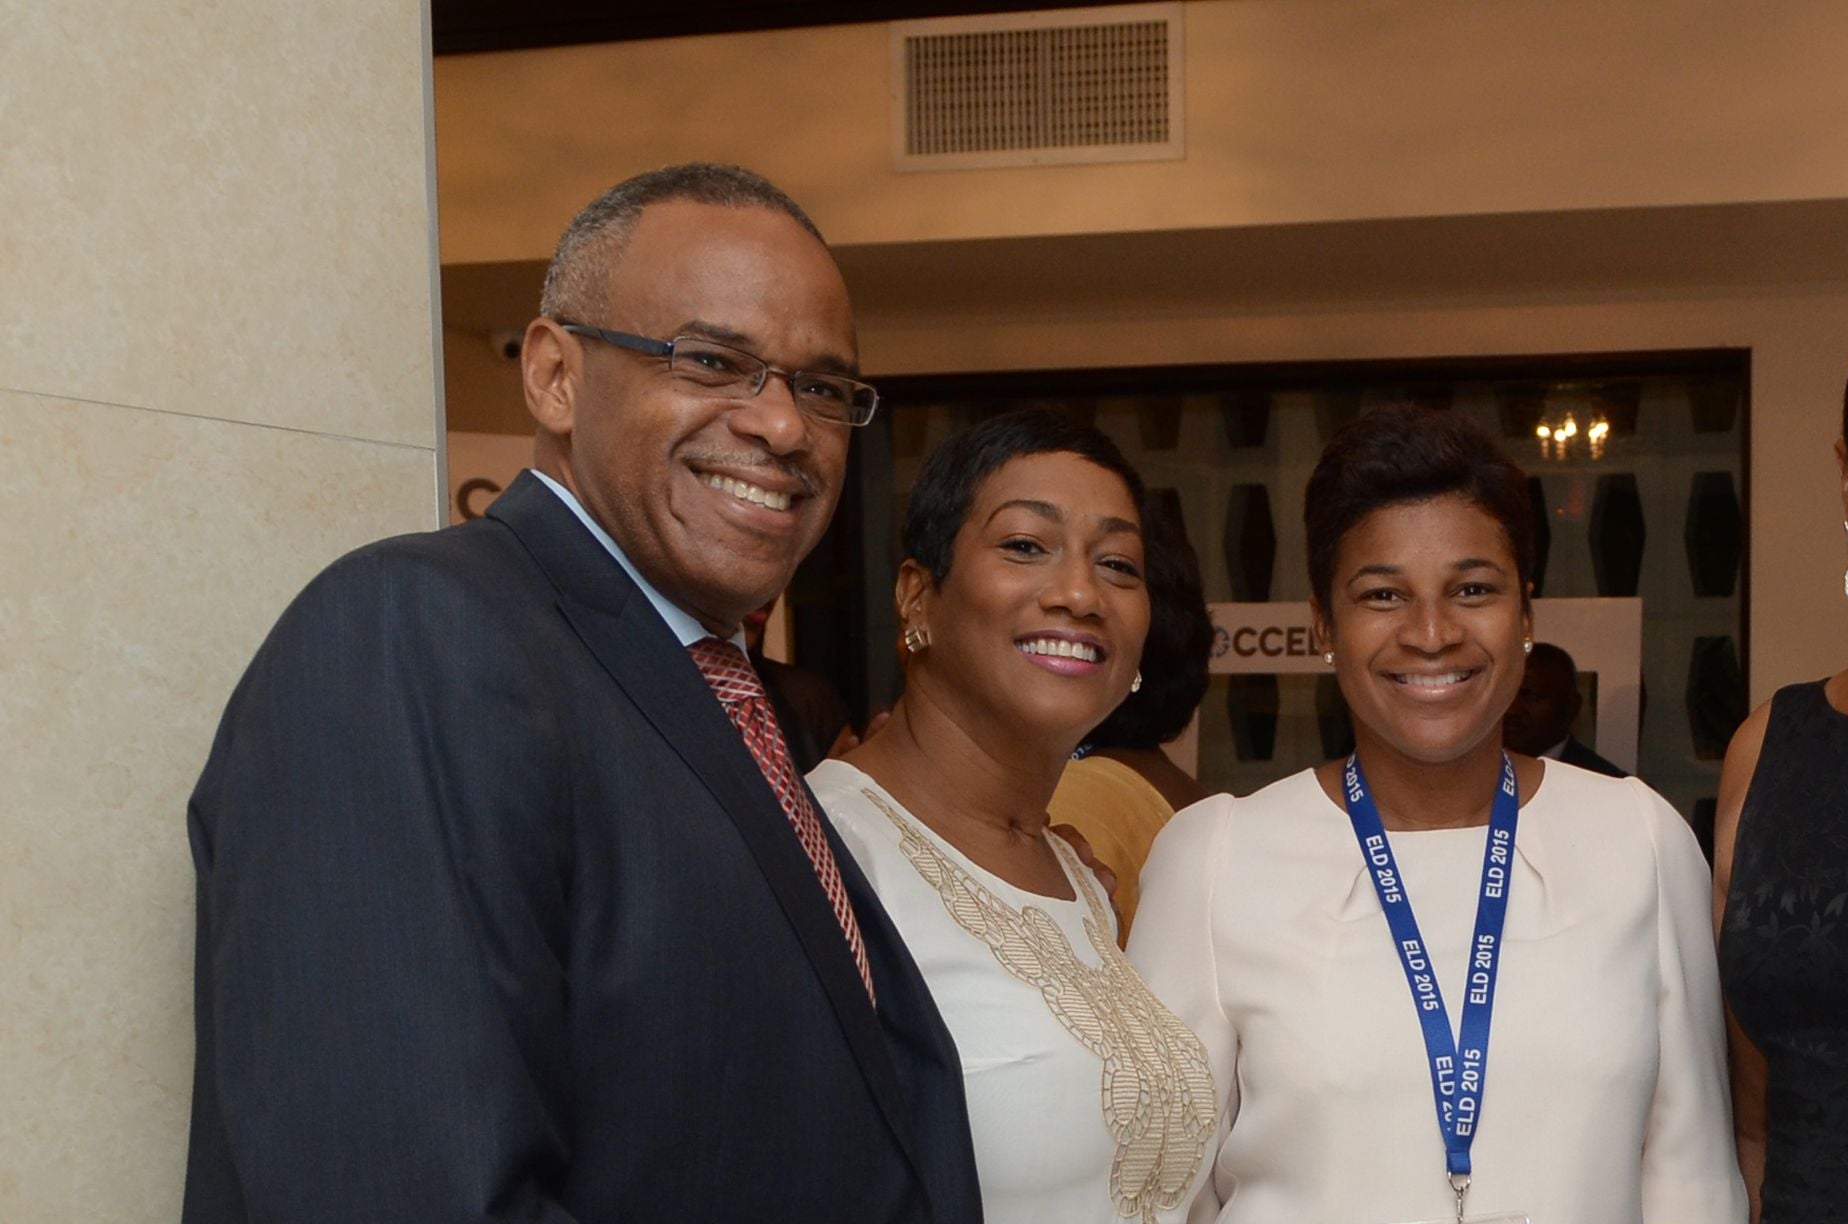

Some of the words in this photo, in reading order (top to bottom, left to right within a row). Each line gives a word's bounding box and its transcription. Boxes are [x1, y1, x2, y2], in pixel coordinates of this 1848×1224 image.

[1365, 834, 1389, 866] ELD
[1490, 829, 1510, 865] 2015
[1376, 868, 1402, 904] 2015
[1485, 867, 1504, 898] ELD
[1475, 934, 1495, 969] 2015
[1402, 939, 1426, 971] ELD
[1414, 974, 1439, 1011] 2015
[1469, 972, 1489, 1004] ELD
[1435, 1056, 1455, 1095] ELD
[1461, 1048, 1481, 1093] 2015
[1456, 1096, 1476, 1136] ELD
